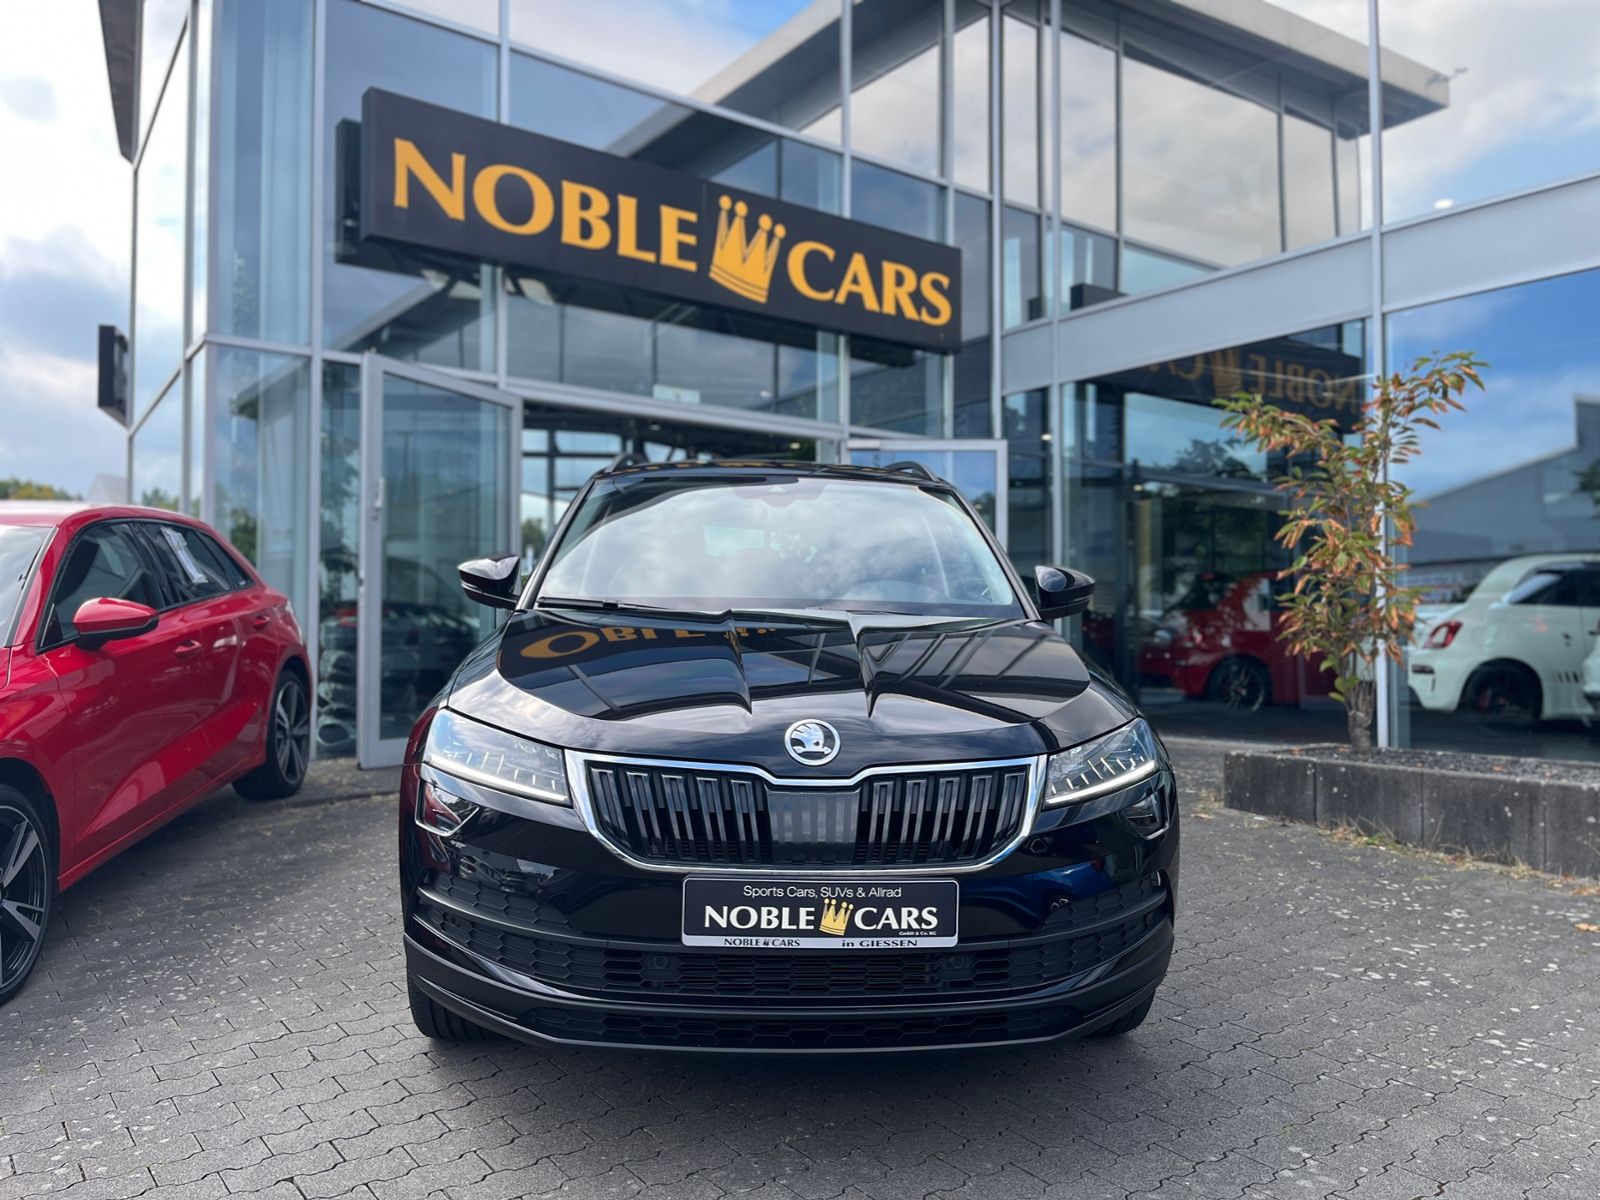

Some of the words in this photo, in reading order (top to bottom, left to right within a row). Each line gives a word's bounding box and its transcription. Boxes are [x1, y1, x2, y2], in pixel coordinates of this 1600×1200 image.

[393, 137, 698, 272] NOBLE
[786, 240, 953, 327] CARS
[743, 885, 784, 898] Sports
[786, 886, 818, 898] Cars,
[820, 886, 854, 898] SUVs
[856, 887, 866, 898] &
[868, 887, 902, 898] Allrad
[704, 905, 815, 930] NOBLE
[854, 906, 938, 930] CARS
[724, 938, 761, 947] NOBLE
[771, 938, 800, 947] CARS
